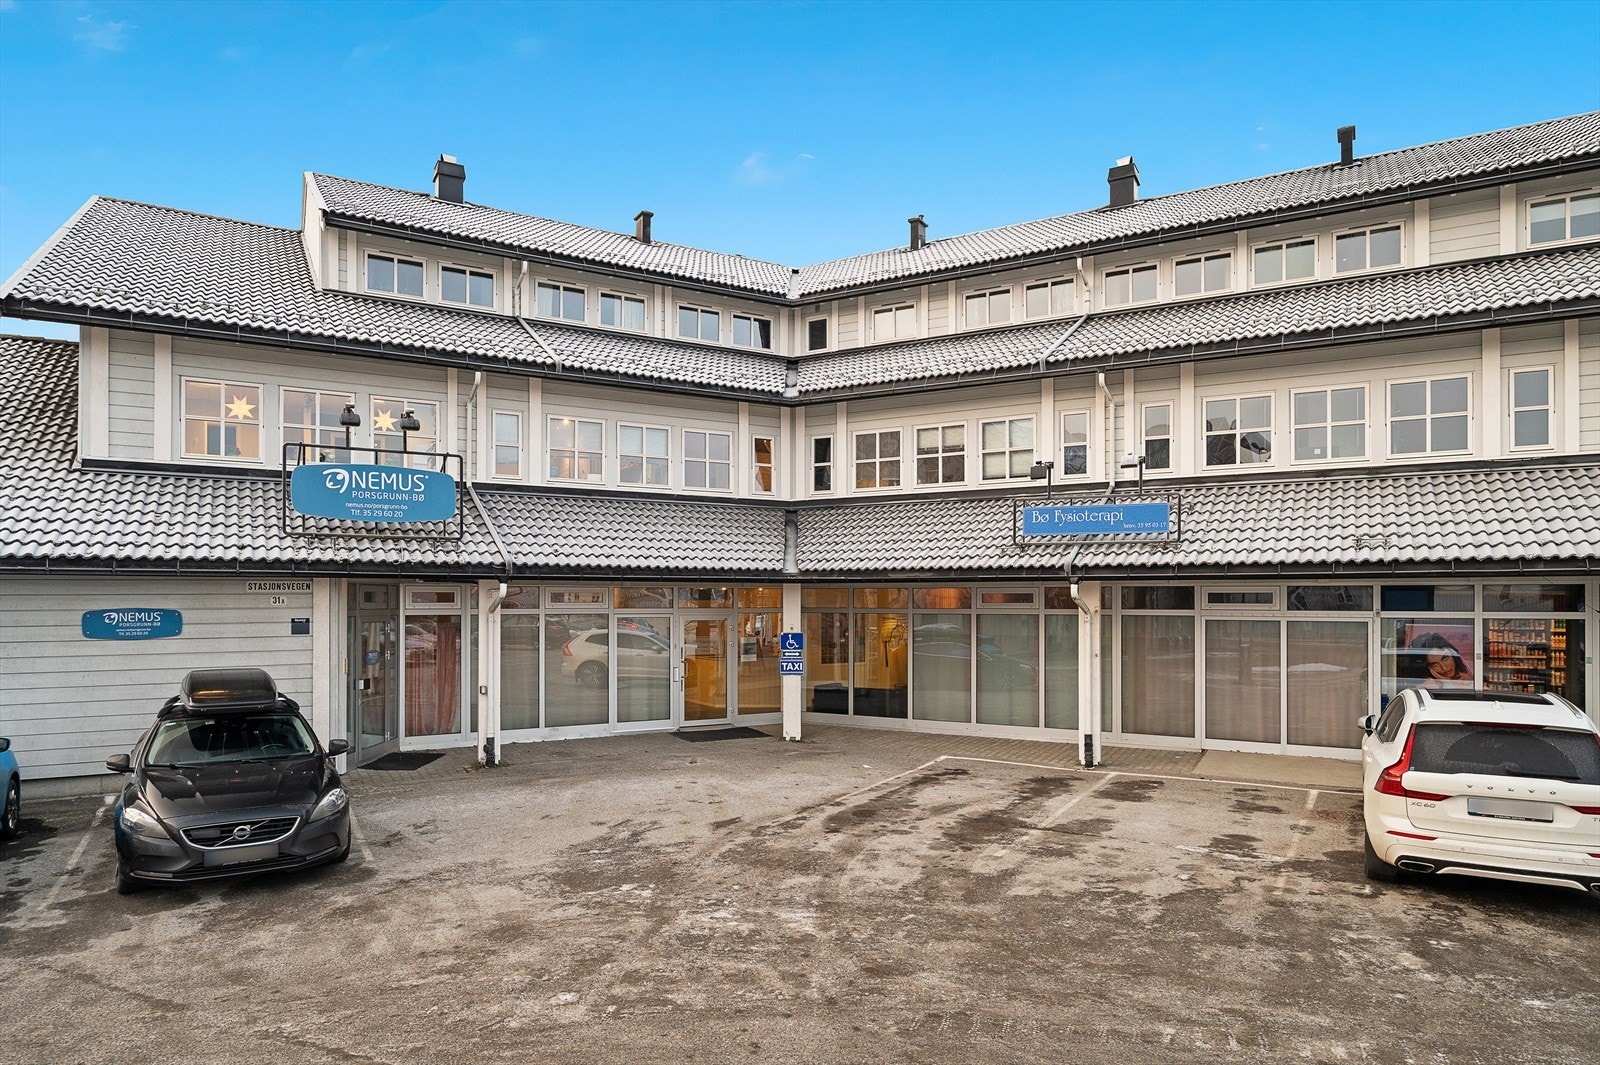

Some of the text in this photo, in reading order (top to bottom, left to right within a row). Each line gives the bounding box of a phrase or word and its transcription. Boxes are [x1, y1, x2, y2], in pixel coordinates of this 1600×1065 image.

[351, 470, 425, 492] NEMUS
[351, 491, 425, 501] PORSGRUNN-BØ
[362, 509, 372, 517] 35
[1032, 508, 1124, 526] Bø Fysioterapi
[247, 582, 311, 590] STASJONSVEGEN
[119, 612, 161, 622] NEMUS
[781, 662, 803, 671] TAXI
[1466, 784, 1556, 795] VOLVO
